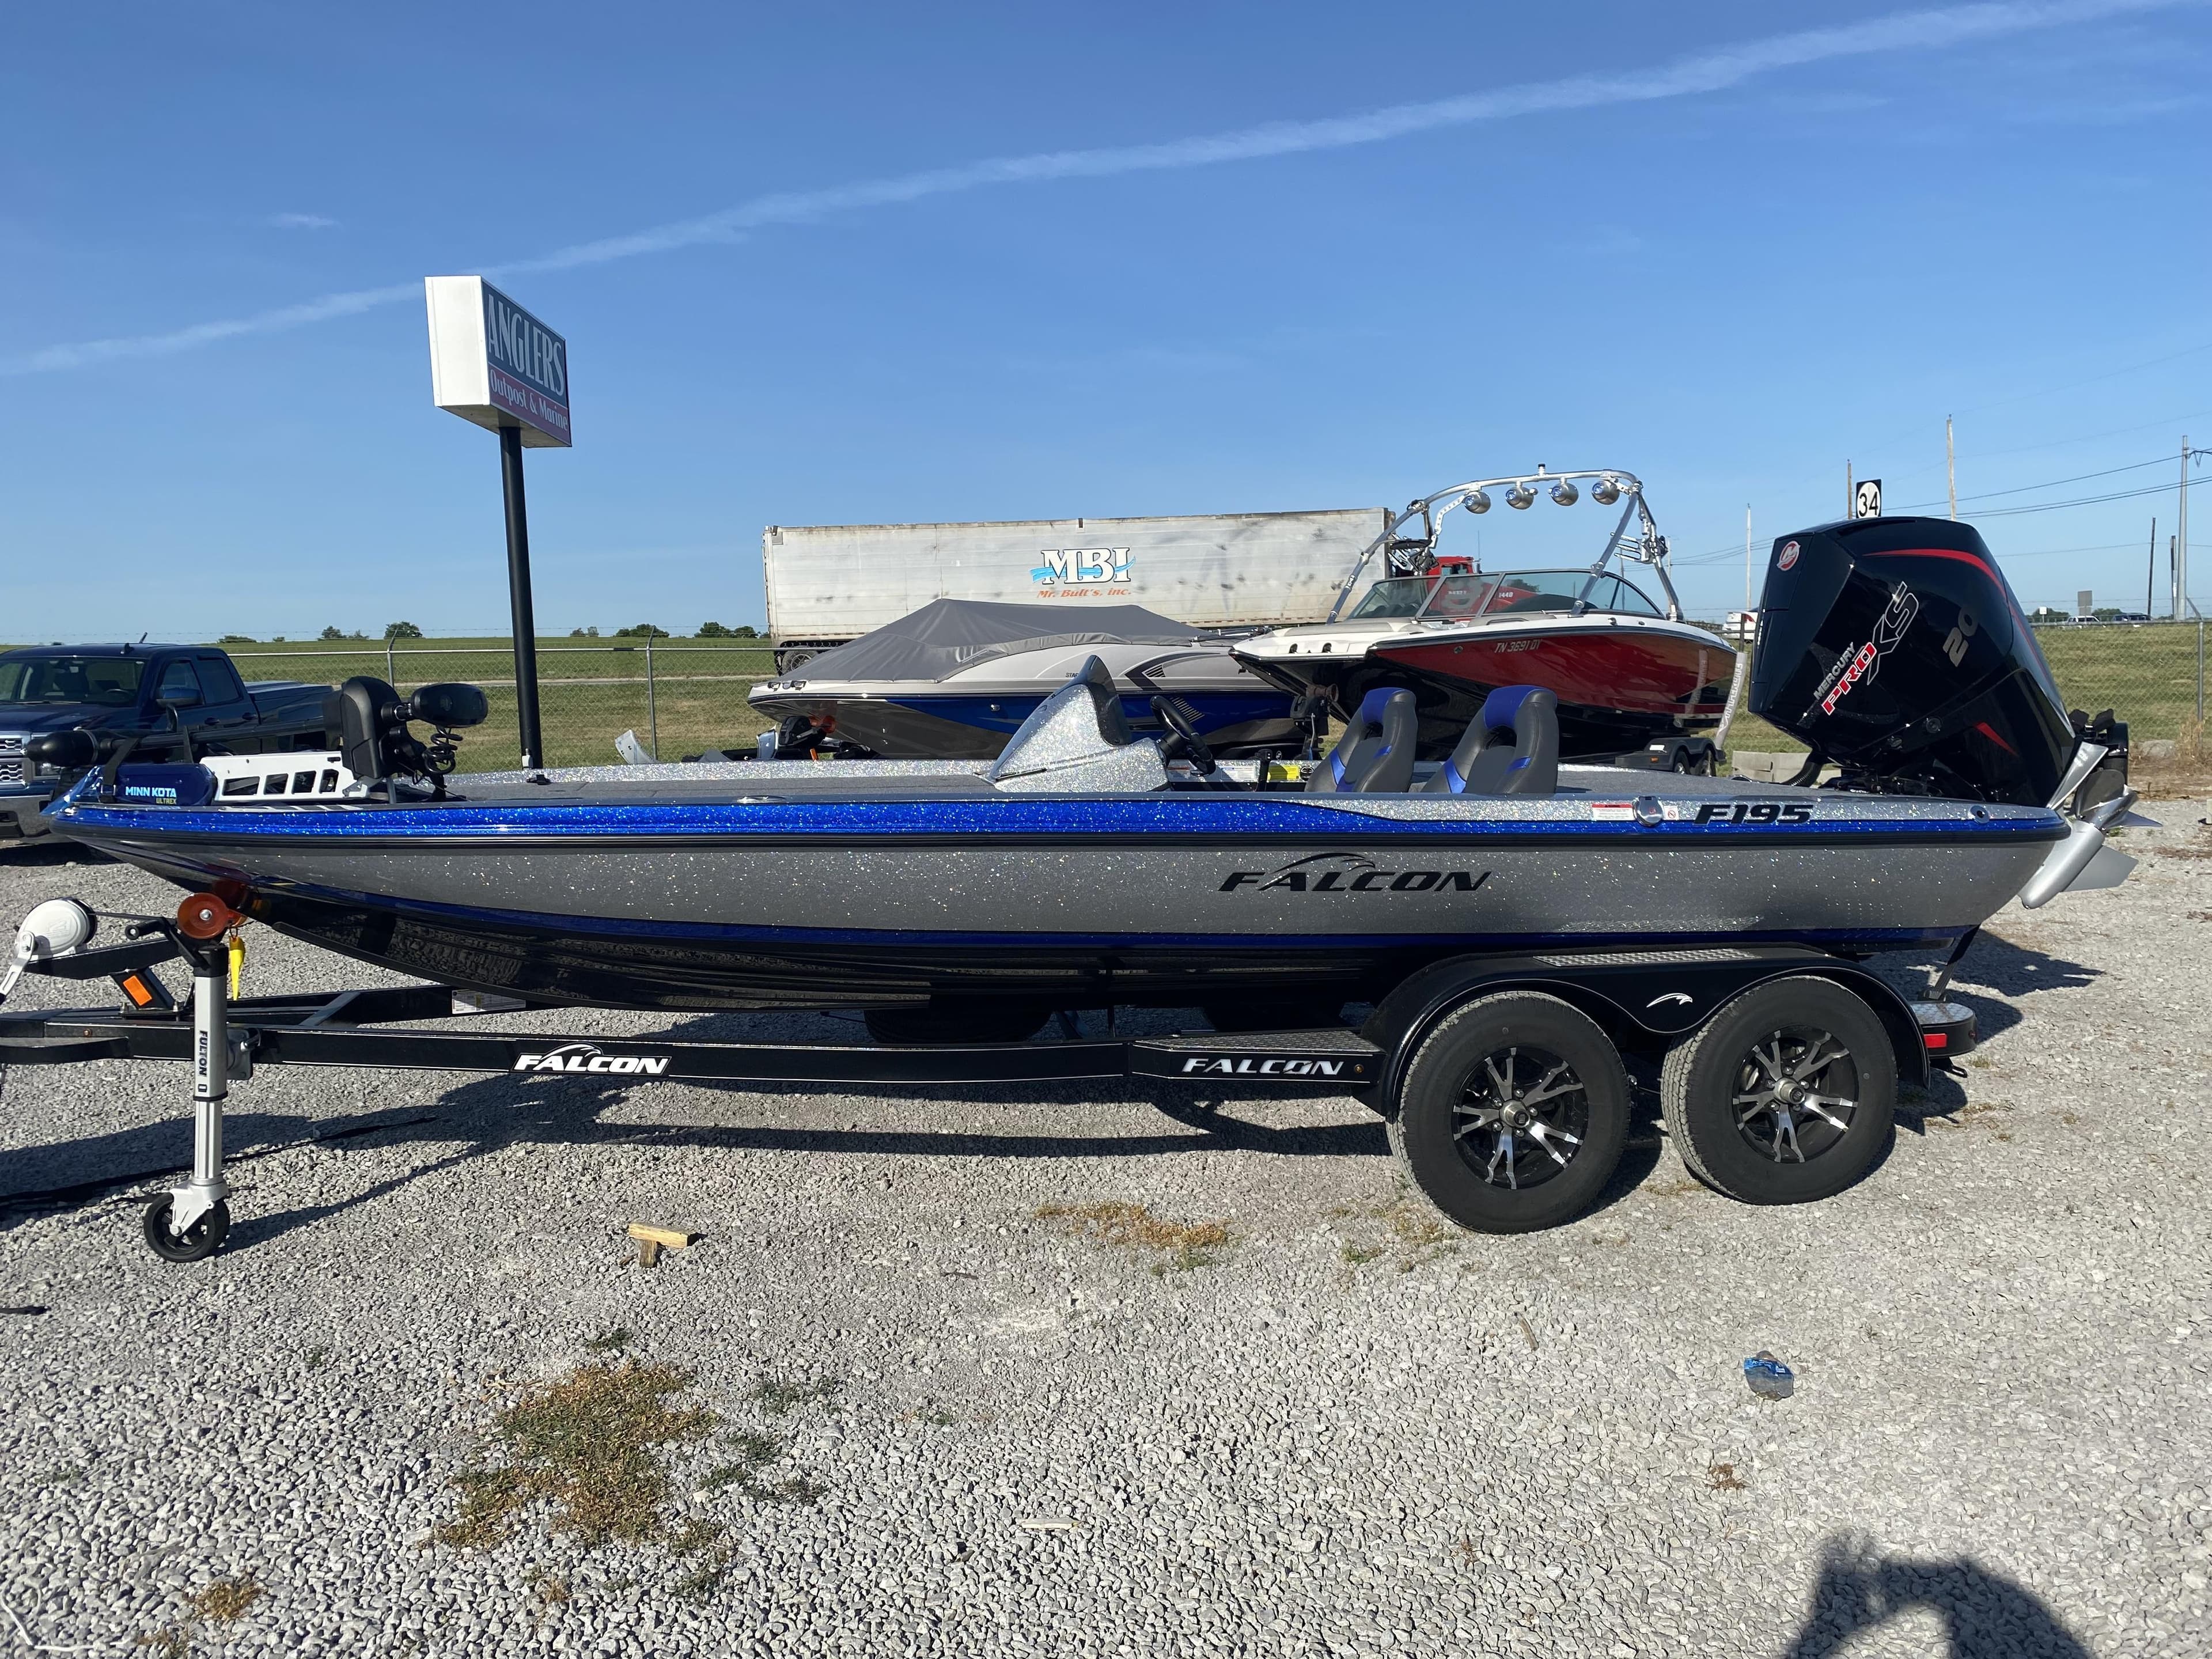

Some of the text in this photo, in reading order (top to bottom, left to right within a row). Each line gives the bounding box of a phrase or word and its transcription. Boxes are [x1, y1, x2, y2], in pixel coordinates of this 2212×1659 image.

[488, 294, 564, 396] ANGLERS
[490, 369, 568, 431] Outpost & Marine
[1859, 491, 1878, 517] 34
[1041, 548, 1131, 585] MBI
[1037, 589, 1055, 599] Mr.
[1494, 642, 1508, 653] TN
[1821, 581, 1919, 715] PRO XS
[1813, 642, 1855, 700] MERCURY
[126, 786, 176, 798] MINN KOTA
[1692, 804, 1813, 825] F195
[1218, 871, 1492, 892] FALCON
[199, 1031, 207, 1076] FULTON
[514, 1055, 669, 1074] FALCON
[1181, 1058, 1344, 1075] FALCON
